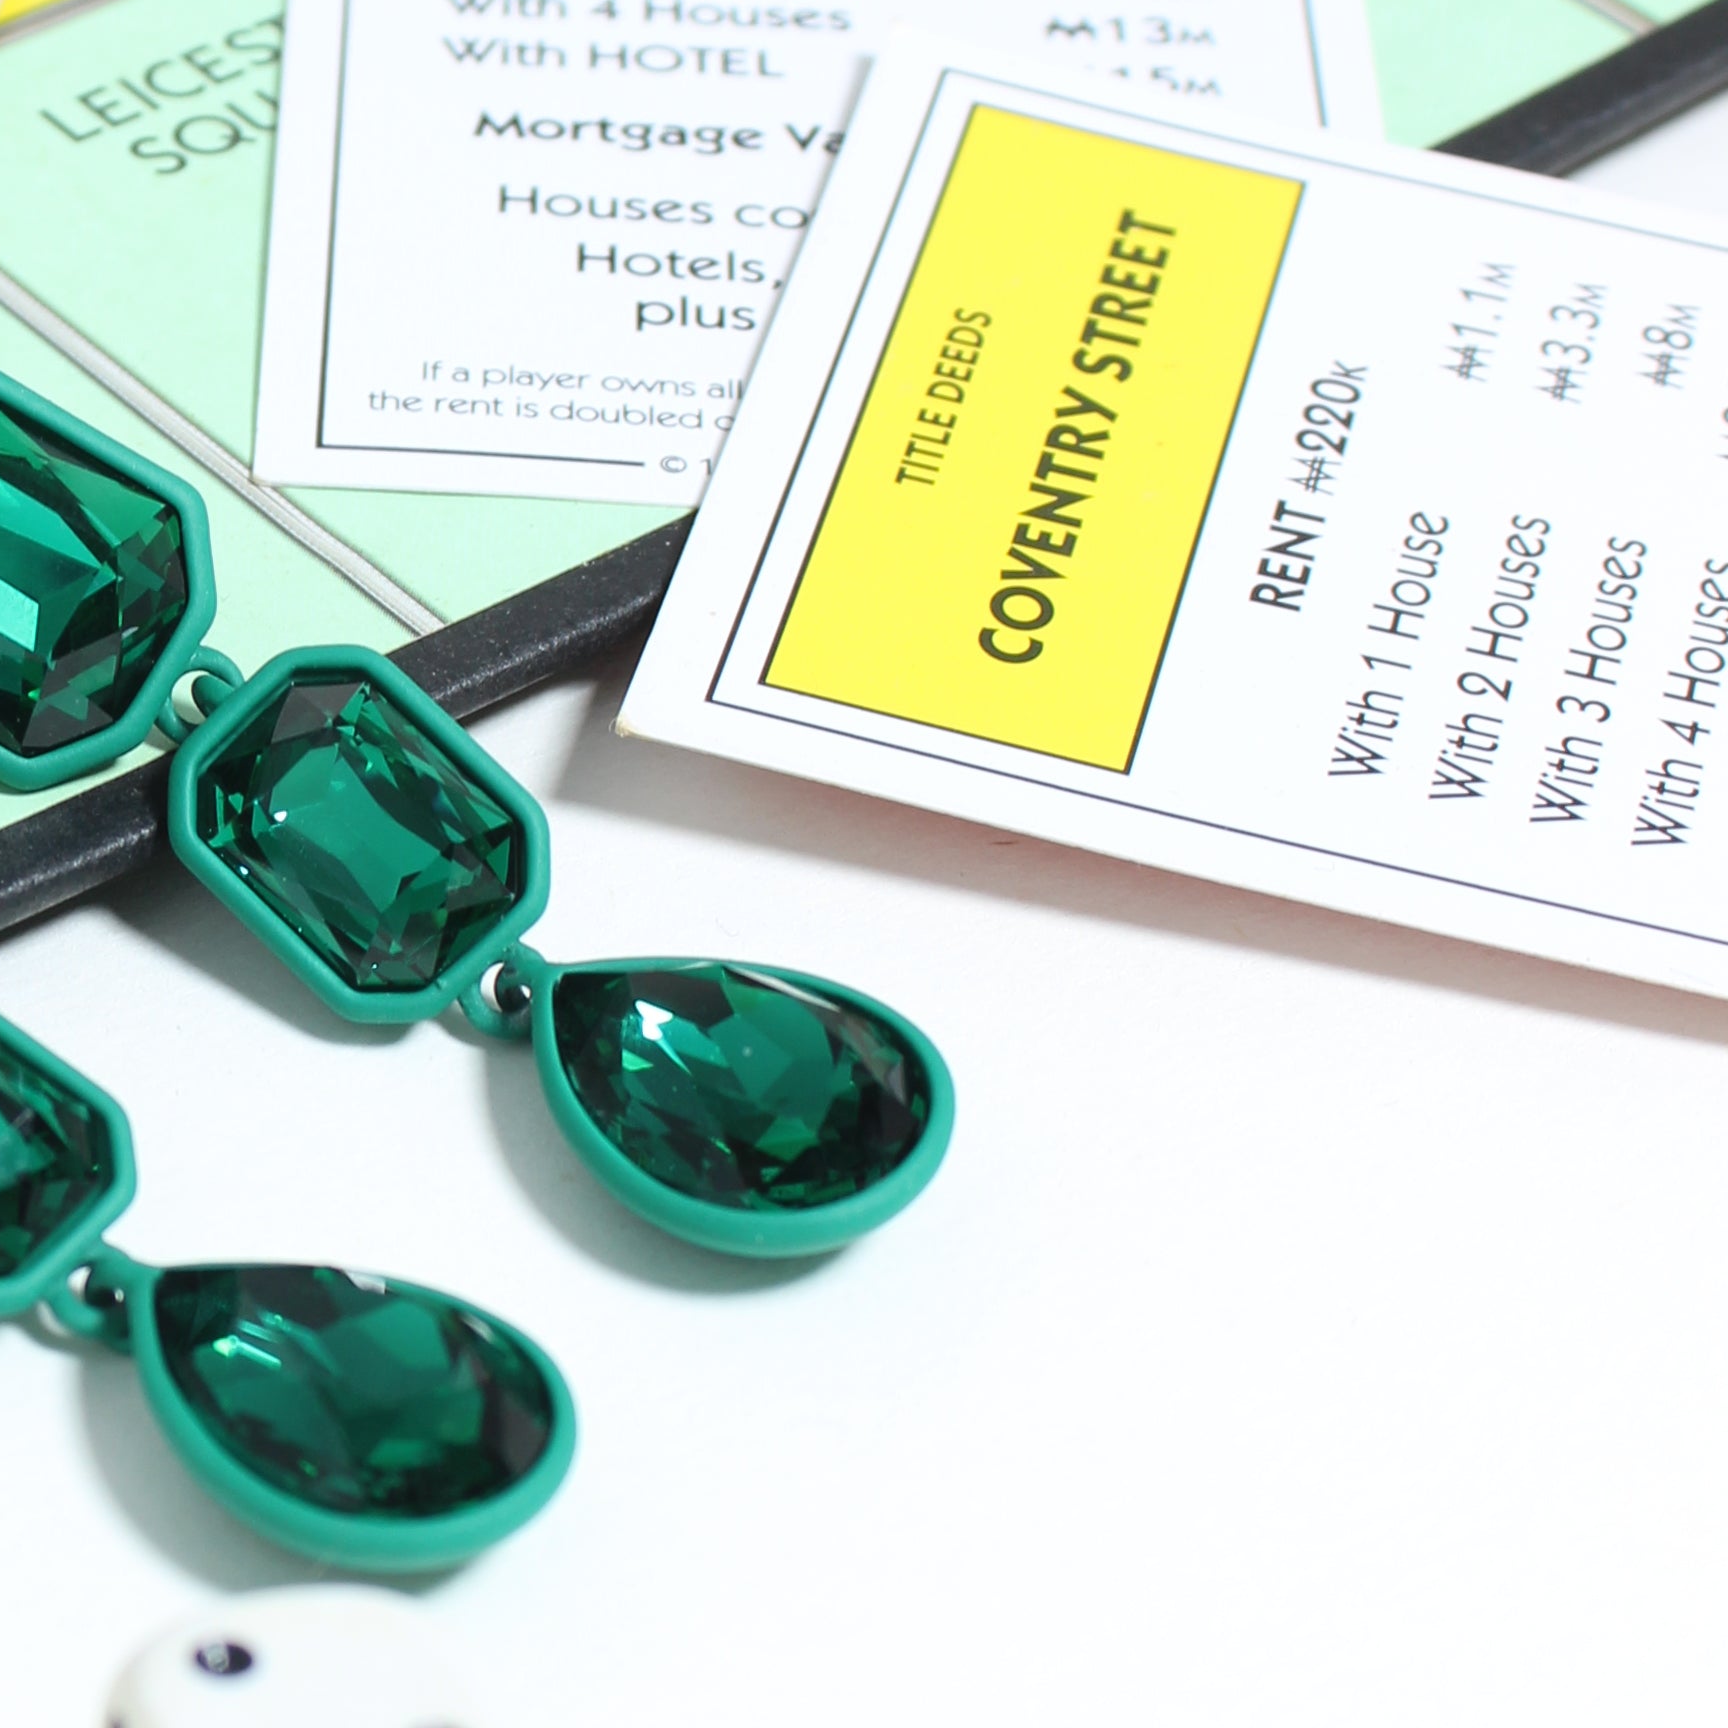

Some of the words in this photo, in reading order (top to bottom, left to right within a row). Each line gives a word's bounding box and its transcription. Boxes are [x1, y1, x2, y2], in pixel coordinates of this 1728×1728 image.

[442, 36, 567, 68] With
[588, 42, 786, 78] HOTEL
[473, 110, 765, 156] Mortgage
[497, 183, 714, 225] Houses
[577, 242, 783, 290] Hotels,
[636, 295, 758, 332] plus
[421, 359, 443, 382] If
[451, 365, 471, 383] a
[481, 363, 590, 391] player
[601, 374, 697, 398] owns
[707, 377, 744, 401] all
[925, 307, 993, 405] DEEDS
[368, 389, 423, 414] the
[433, 394, 504, 419] rent
[515, 397, 539, 420] is
[549, 399, 703, 432] doubled
[978, 385, 1120, 665] COVENTRY
[1071, 208, 1178, 383] STREET
[894, 407, 959, 487] TITLE
[1248, 499, 1327, 612] RENT
[1367, 511, 1451, 641] House
[1465, 513, 1552, 664] Houses
[1563, 535, 1649, 686] Houses
[1361, 653, 1412, 670] 1
[1455, 671, 1513, 703] 2
[1327, 689, 1405, 777] With
[1555, 694, 1612, 724] 3
[1657, 716, 1712, 747] 4
[1427, 712, 1504, 800] With
[1529, 735, 1604, 823] With
[1630, 758, 1705, 846] With
